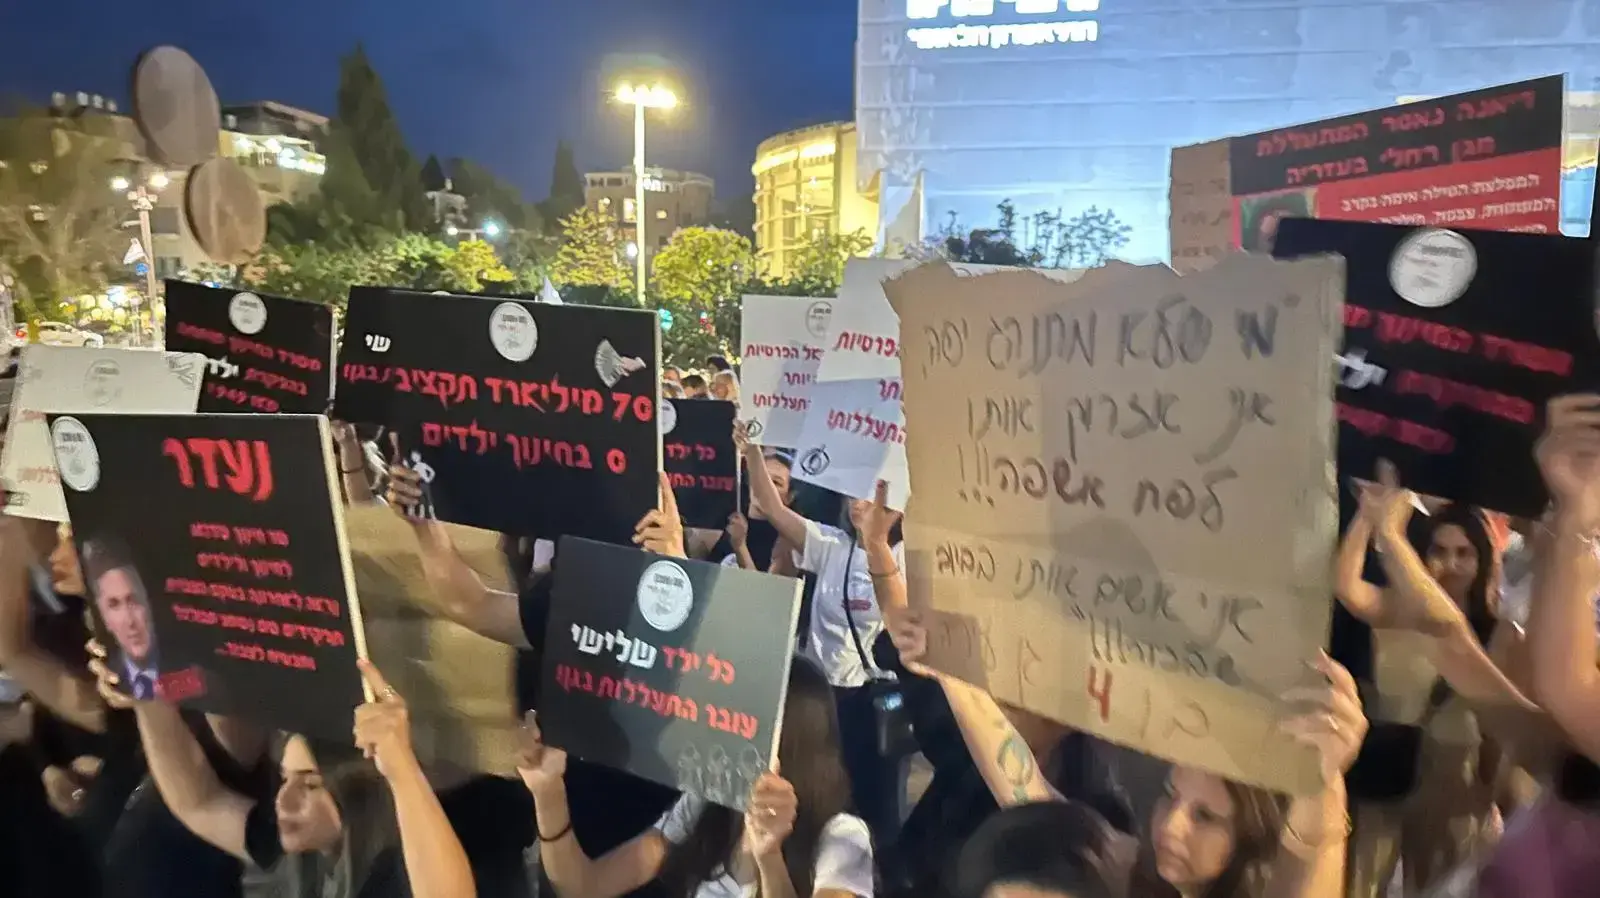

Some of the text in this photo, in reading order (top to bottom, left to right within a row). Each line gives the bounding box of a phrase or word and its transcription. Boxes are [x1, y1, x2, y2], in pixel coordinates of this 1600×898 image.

[1256, 121, 1370, 157] המתעללת
[1381, 192, 1419, 208] אימה
[987, 308, 1098, 379] מתנהג
[1117, 294, 1213, 370] שלא
[395, 367, 477, 410] תקציב
[484, 372, 603, 414] מיליארד
[612, 392, 653, 422] 70
[422, 419, 497, 454] ילדים
[967, 395, 1035, 440] אותו
[1067, 393, 1181, 463] אזרוק
[1194, 386, 1276, 464] אני
[162, 437, 275, 501] נעדר
[505, 434, 592, 470] בחינוך
[696, 443, 716, 462] כל
[1133, 465, 1238, 533] לפח
[1014, 558, 1080, 600] אותו
[1095, 573, 1181, 622] אשים
[1200, 592, 1264, 648] אני
[571, 623, 735, 685] כל ילד שלישי
[597, 675, 697, 722] התעללות
[1087, 666, 1112, 723] 4
[706, 703, 758, 739] עובר
